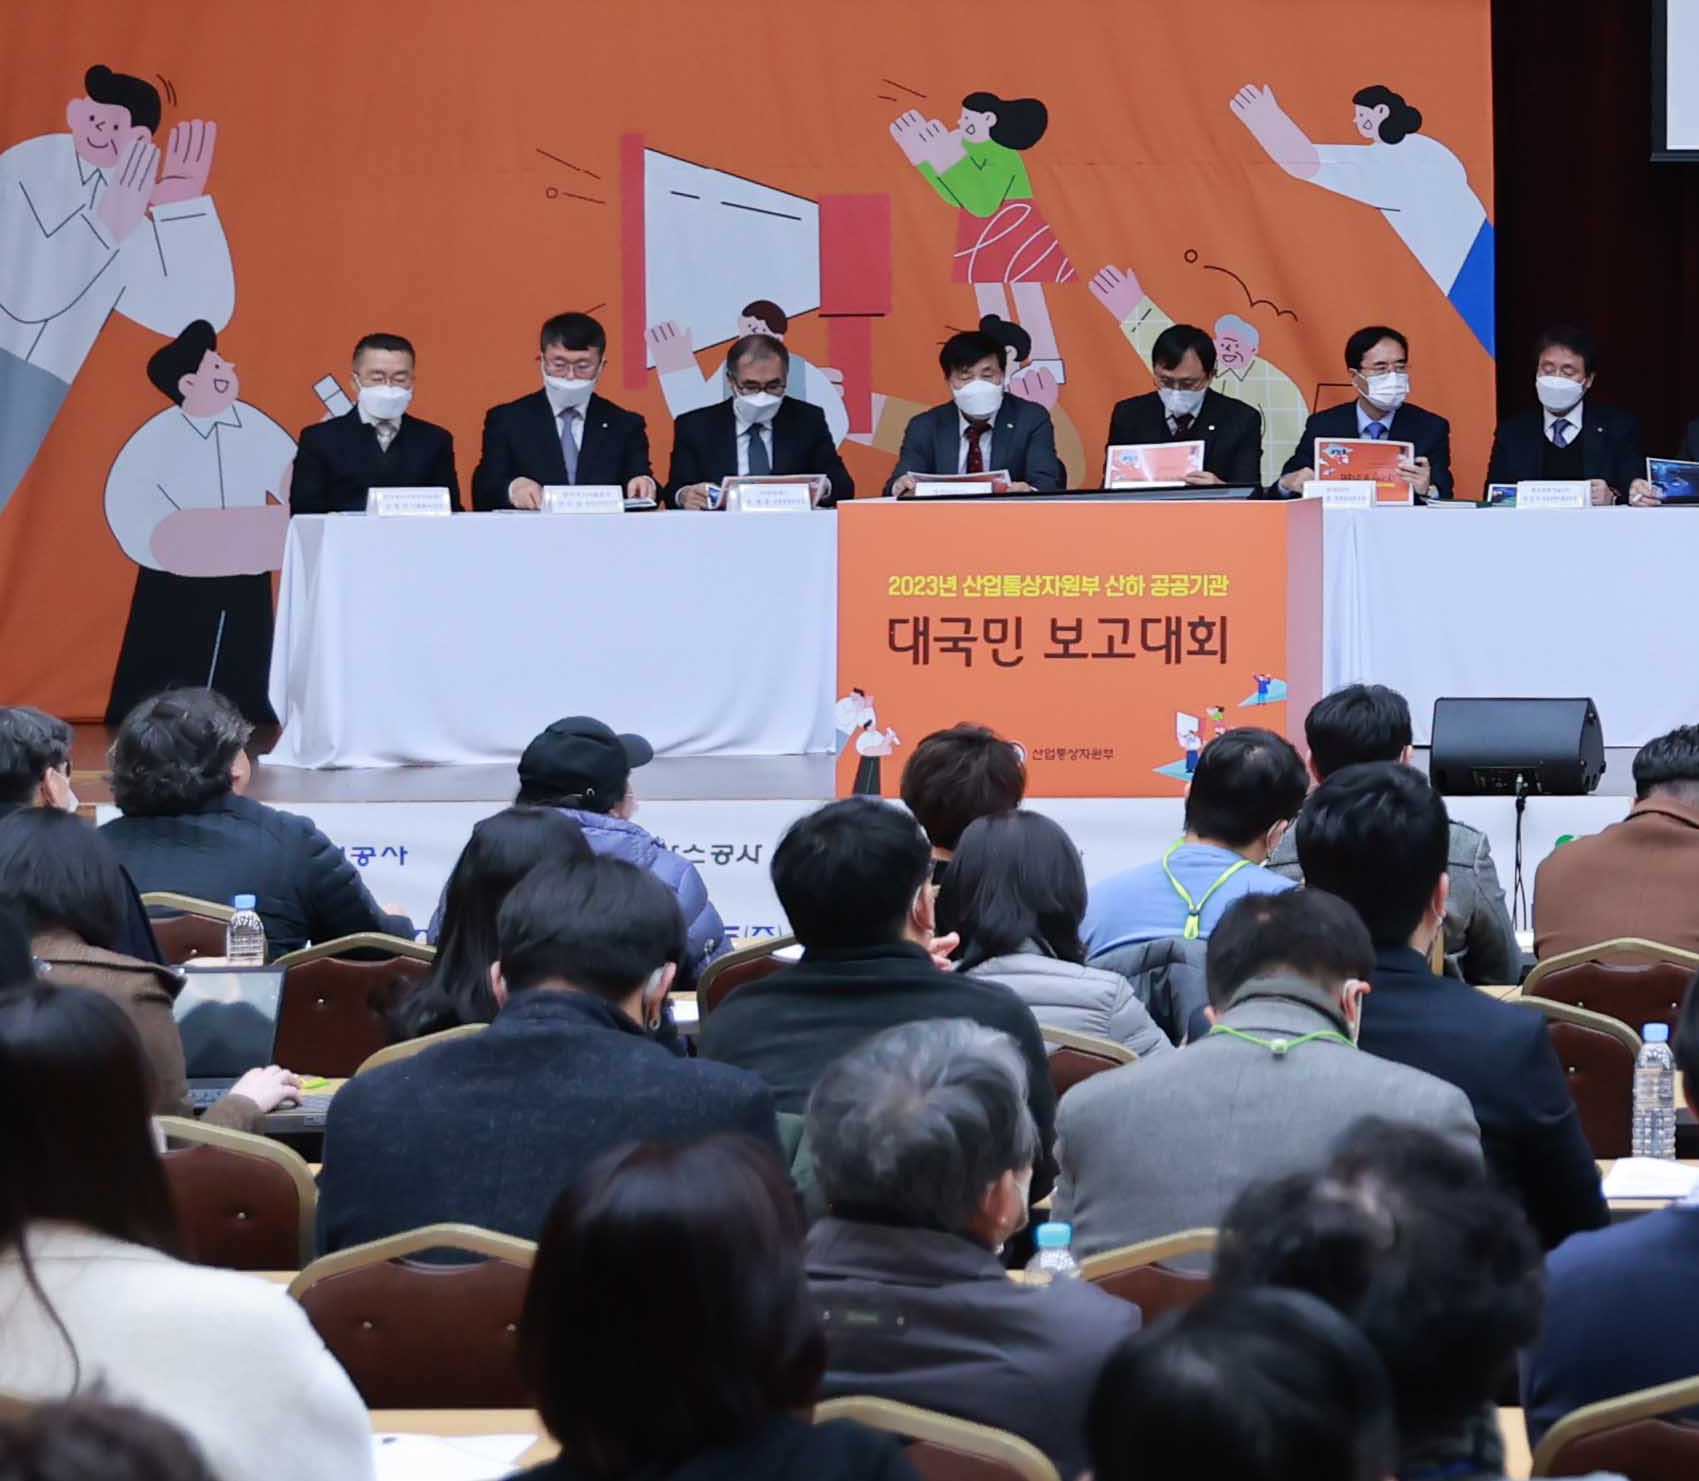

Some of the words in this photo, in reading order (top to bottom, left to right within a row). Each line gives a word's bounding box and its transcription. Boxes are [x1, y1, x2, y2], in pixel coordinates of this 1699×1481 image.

[888, 574, 957, 598] 2023년
[963, 574, 1100, 598] 산업통상자원부
[1106, 574, 1145, 598] 산하
[1150, 574, 1229, 598] 공공기관
[888, 615, 1024, 667] 대국민
[1044, 615, 1228, 664] 보고대회
[1032, 747, 1114, 761] 산업통상자원부
[339, 846, 408, 866] 공사
